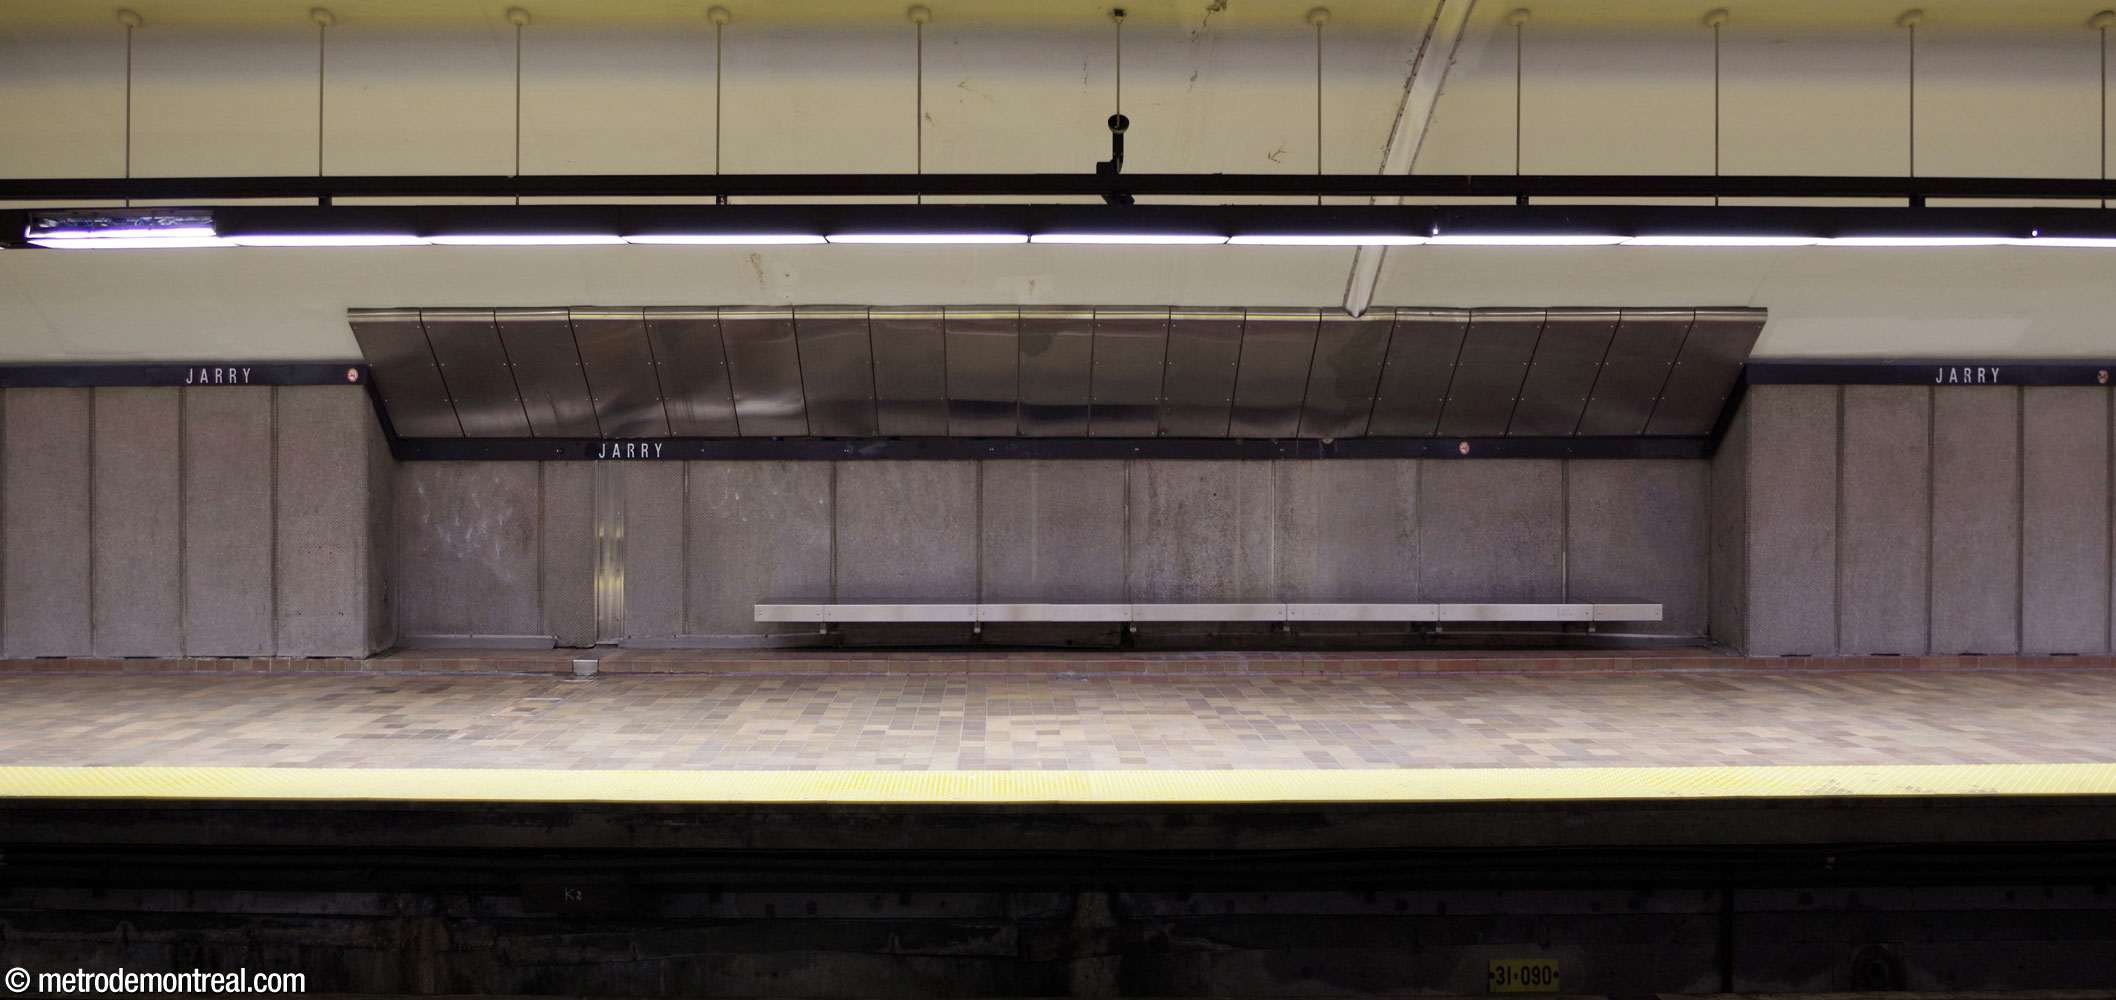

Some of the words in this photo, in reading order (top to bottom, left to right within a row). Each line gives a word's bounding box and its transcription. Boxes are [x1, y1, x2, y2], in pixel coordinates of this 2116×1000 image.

[186, 368, 251, 384] JARRY
[1936, 367, 1999, 383] JARRY
[598, 443, 662, 458] JARRY
